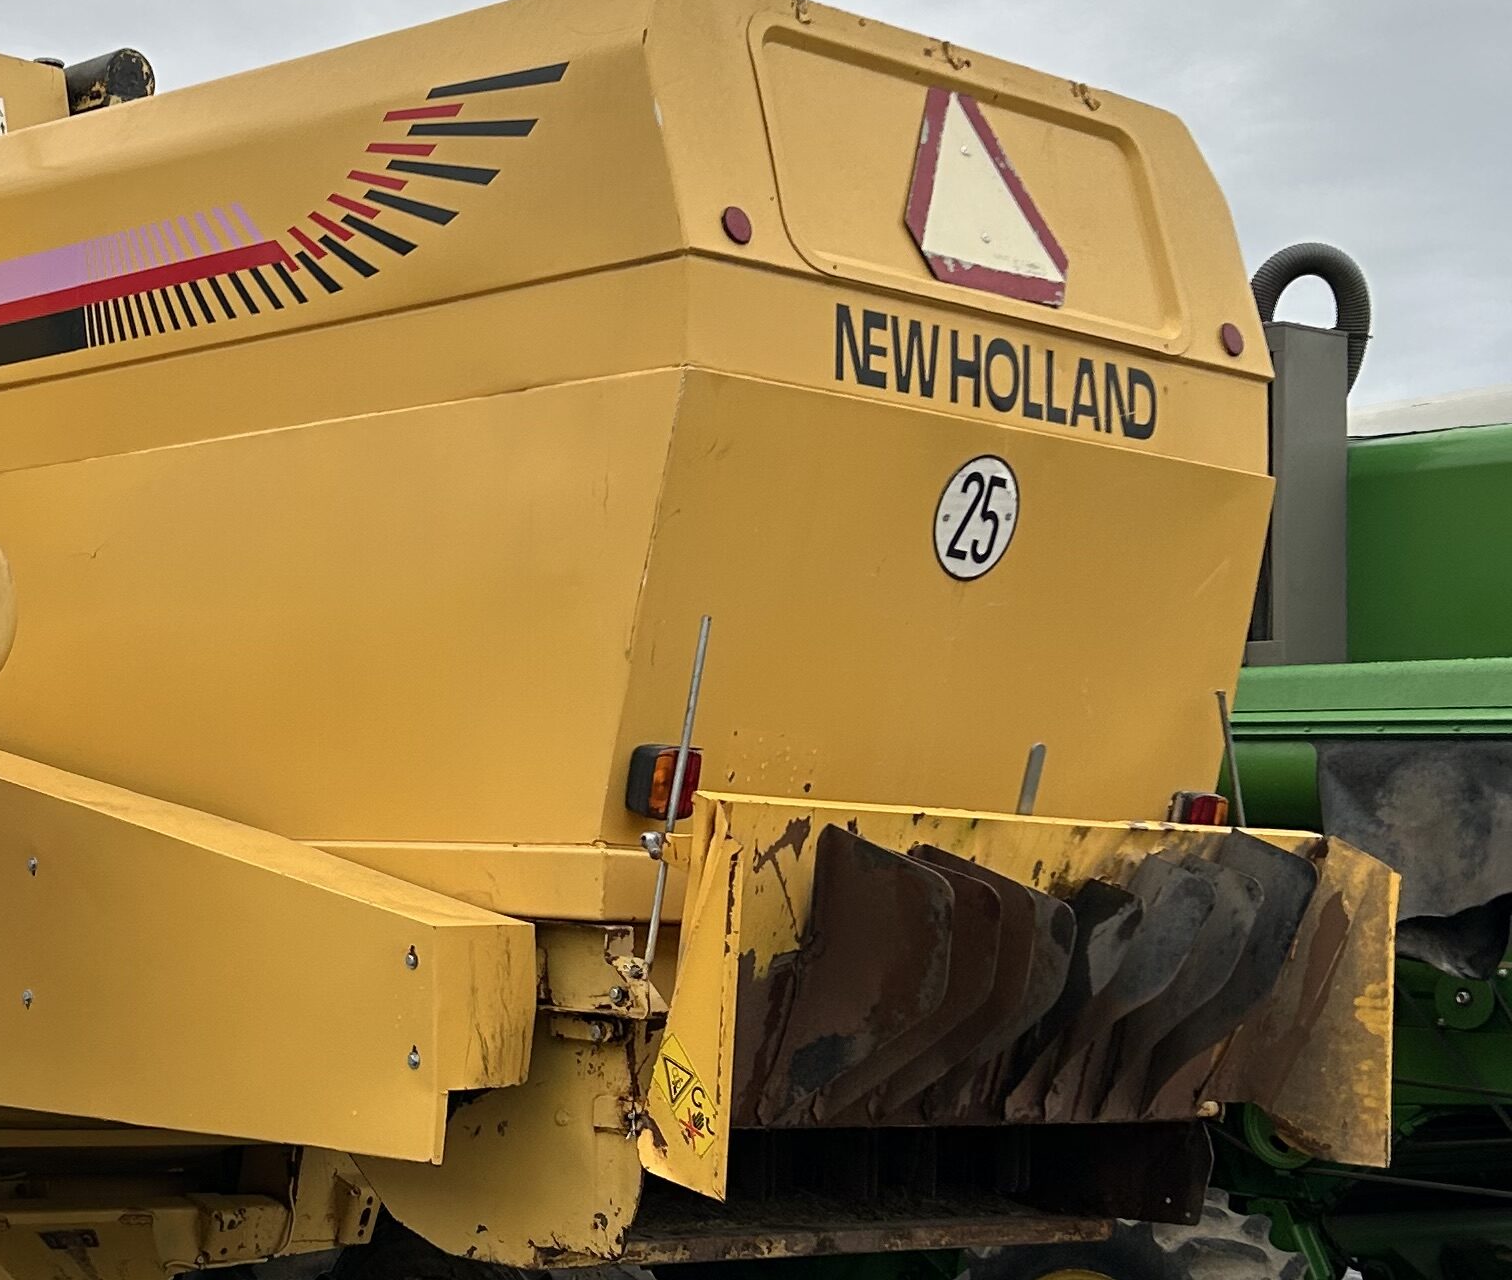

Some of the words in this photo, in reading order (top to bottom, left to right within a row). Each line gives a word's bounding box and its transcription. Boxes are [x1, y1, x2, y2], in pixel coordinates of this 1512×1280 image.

[835, 302, 940, 399] NEW
[950, 329, 1158, 441] HOLLAND
[945, 471, 1008, 565] 25
